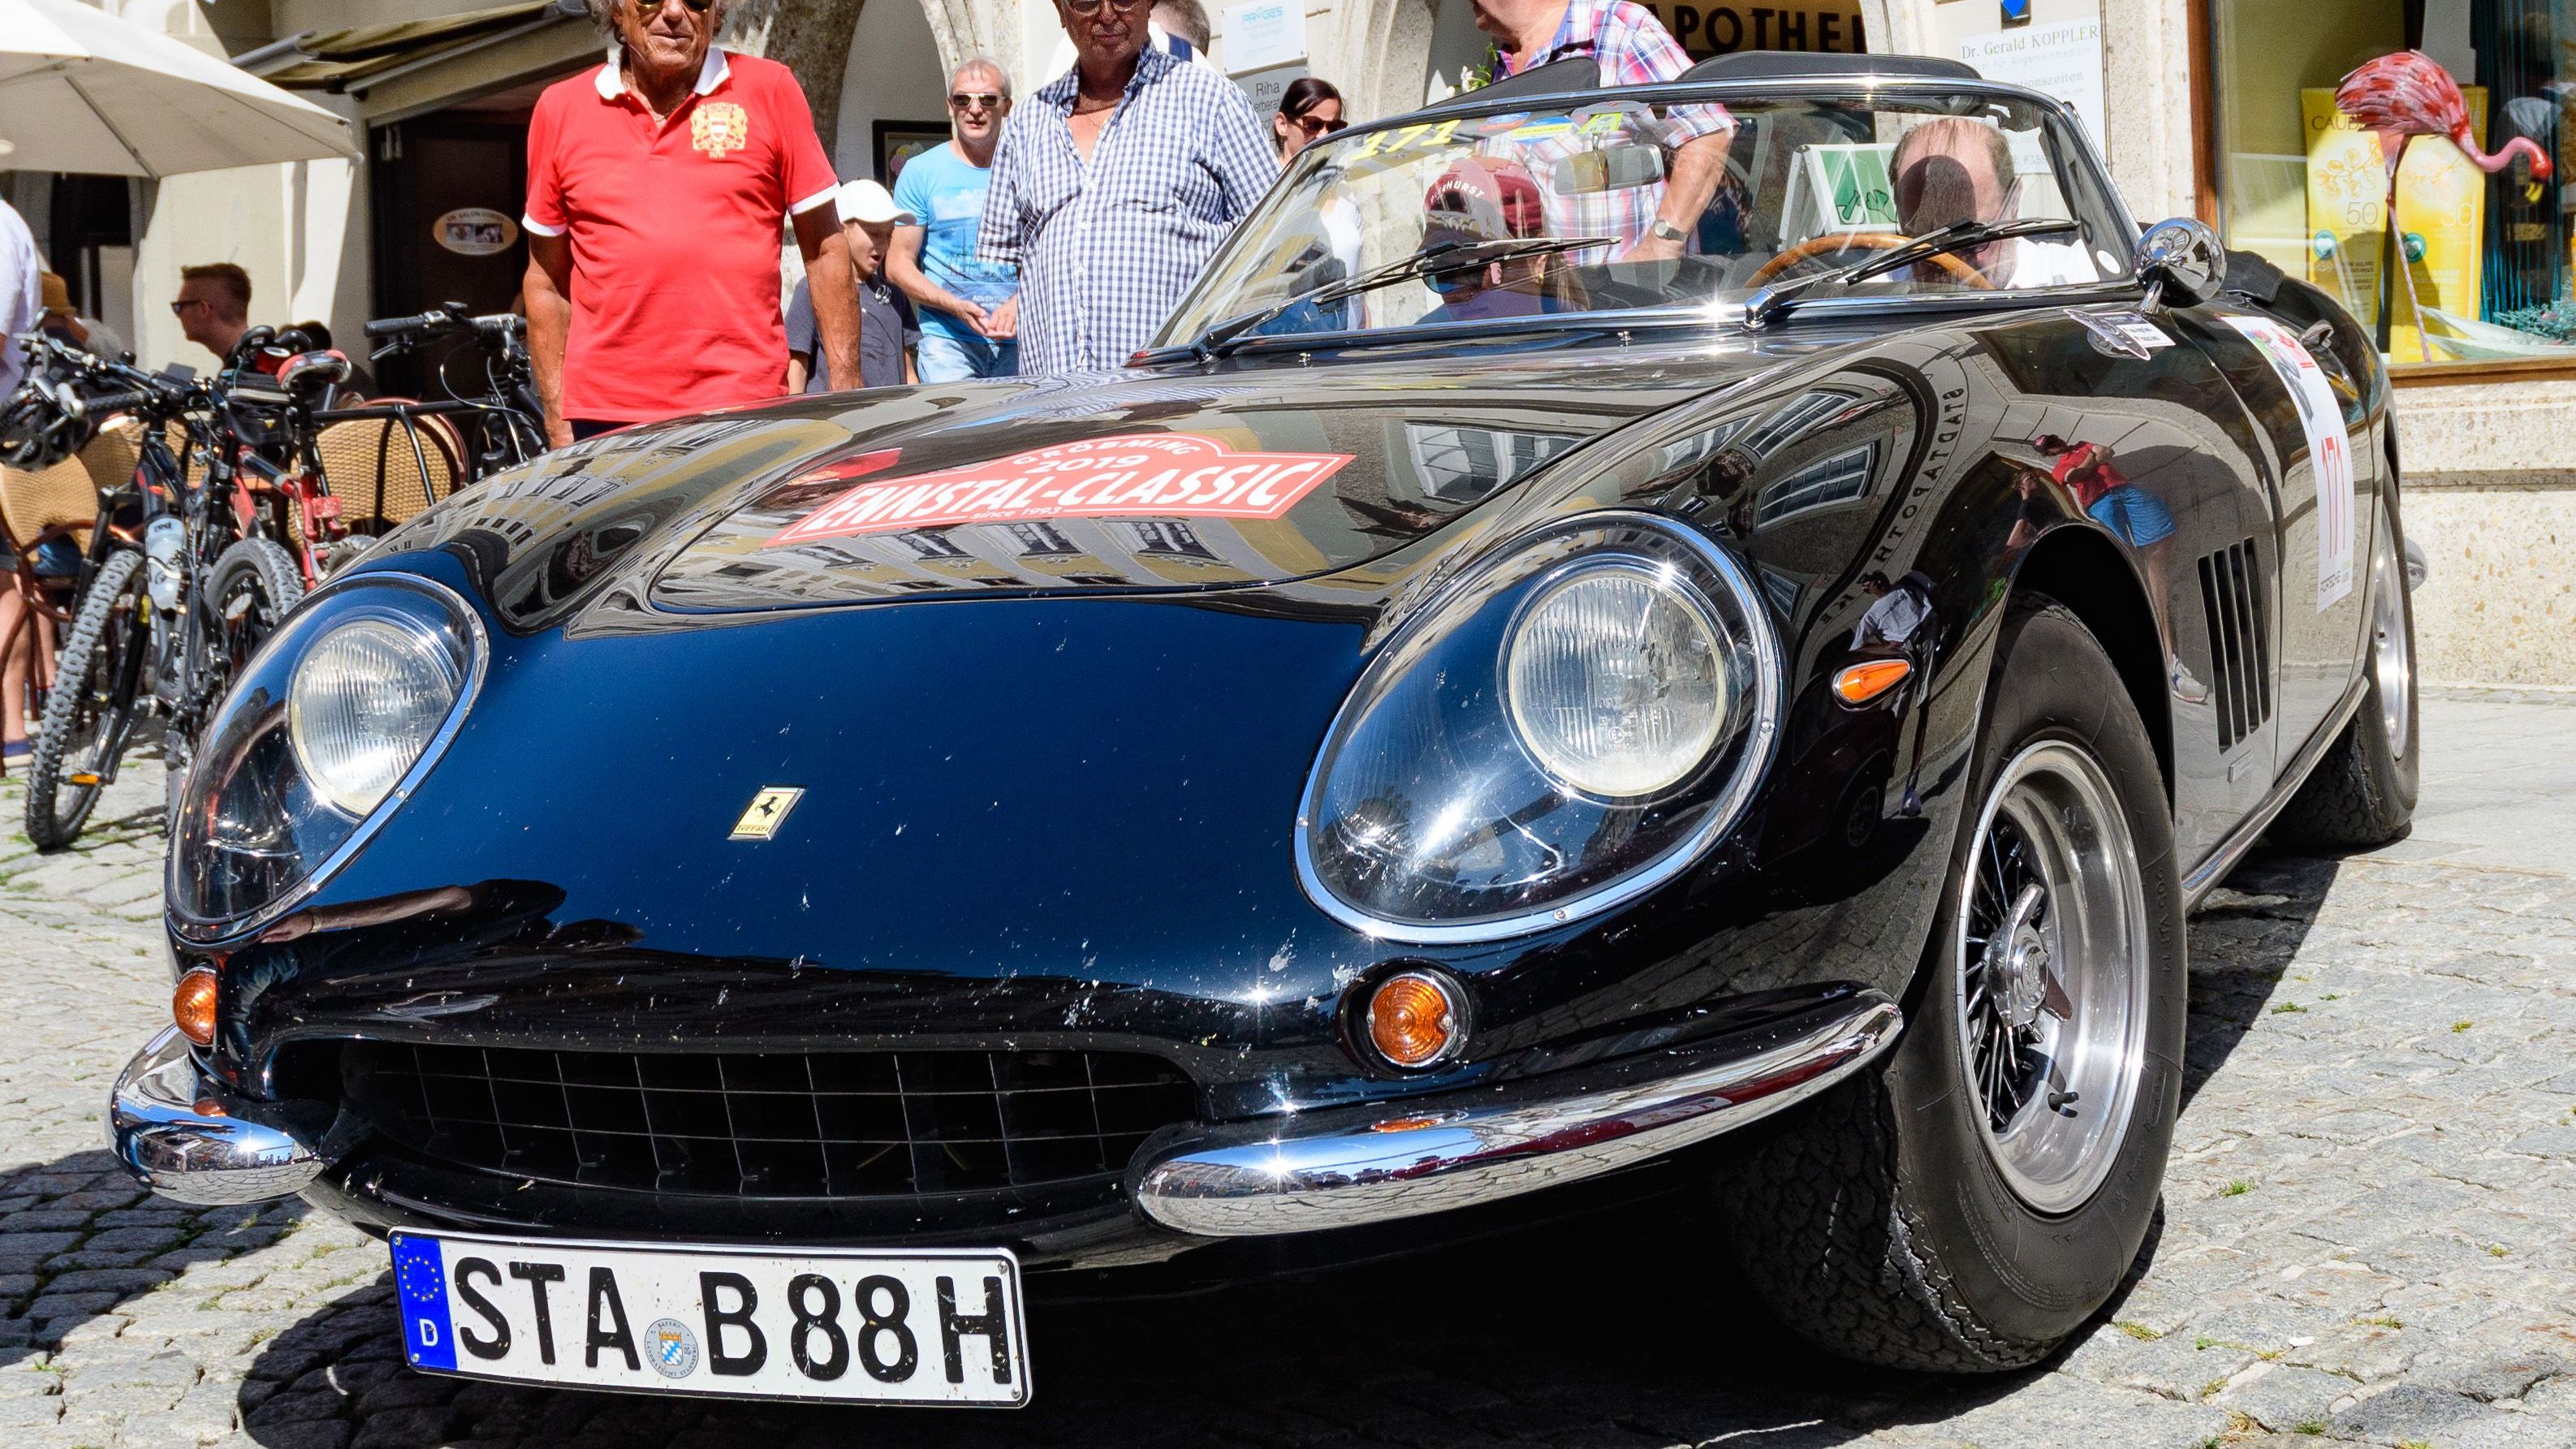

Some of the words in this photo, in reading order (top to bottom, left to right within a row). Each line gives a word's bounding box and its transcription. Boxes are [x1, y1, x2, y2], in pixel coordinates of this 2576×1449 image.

[1961, 45, 1980, 59] Dr.
[1984, 37, 2026, 55] Gerald
[2032, 24, 2099, 49] KOPPLER
[1255, 81, 1280, 96] Riha
[2311, 115, 2364, 131] CAUD
[1350, 120, 1461, 161] 171
[2345, 202, 2378, 226] 50
[2440, 203, 2473, 227] 30
[1012, 439, 1201, 465] GRÖBMING
[1023, 454, 1150, 475] 2019
[801, 461, 1323, 532] ENNSTAL-CLASSIC
[970, 509, 1016, 520] since
[1021, 506, 1062, 517] 1993
[454, 1256, 641, 1371] STA
[421, 1317, 439, 1348] D
